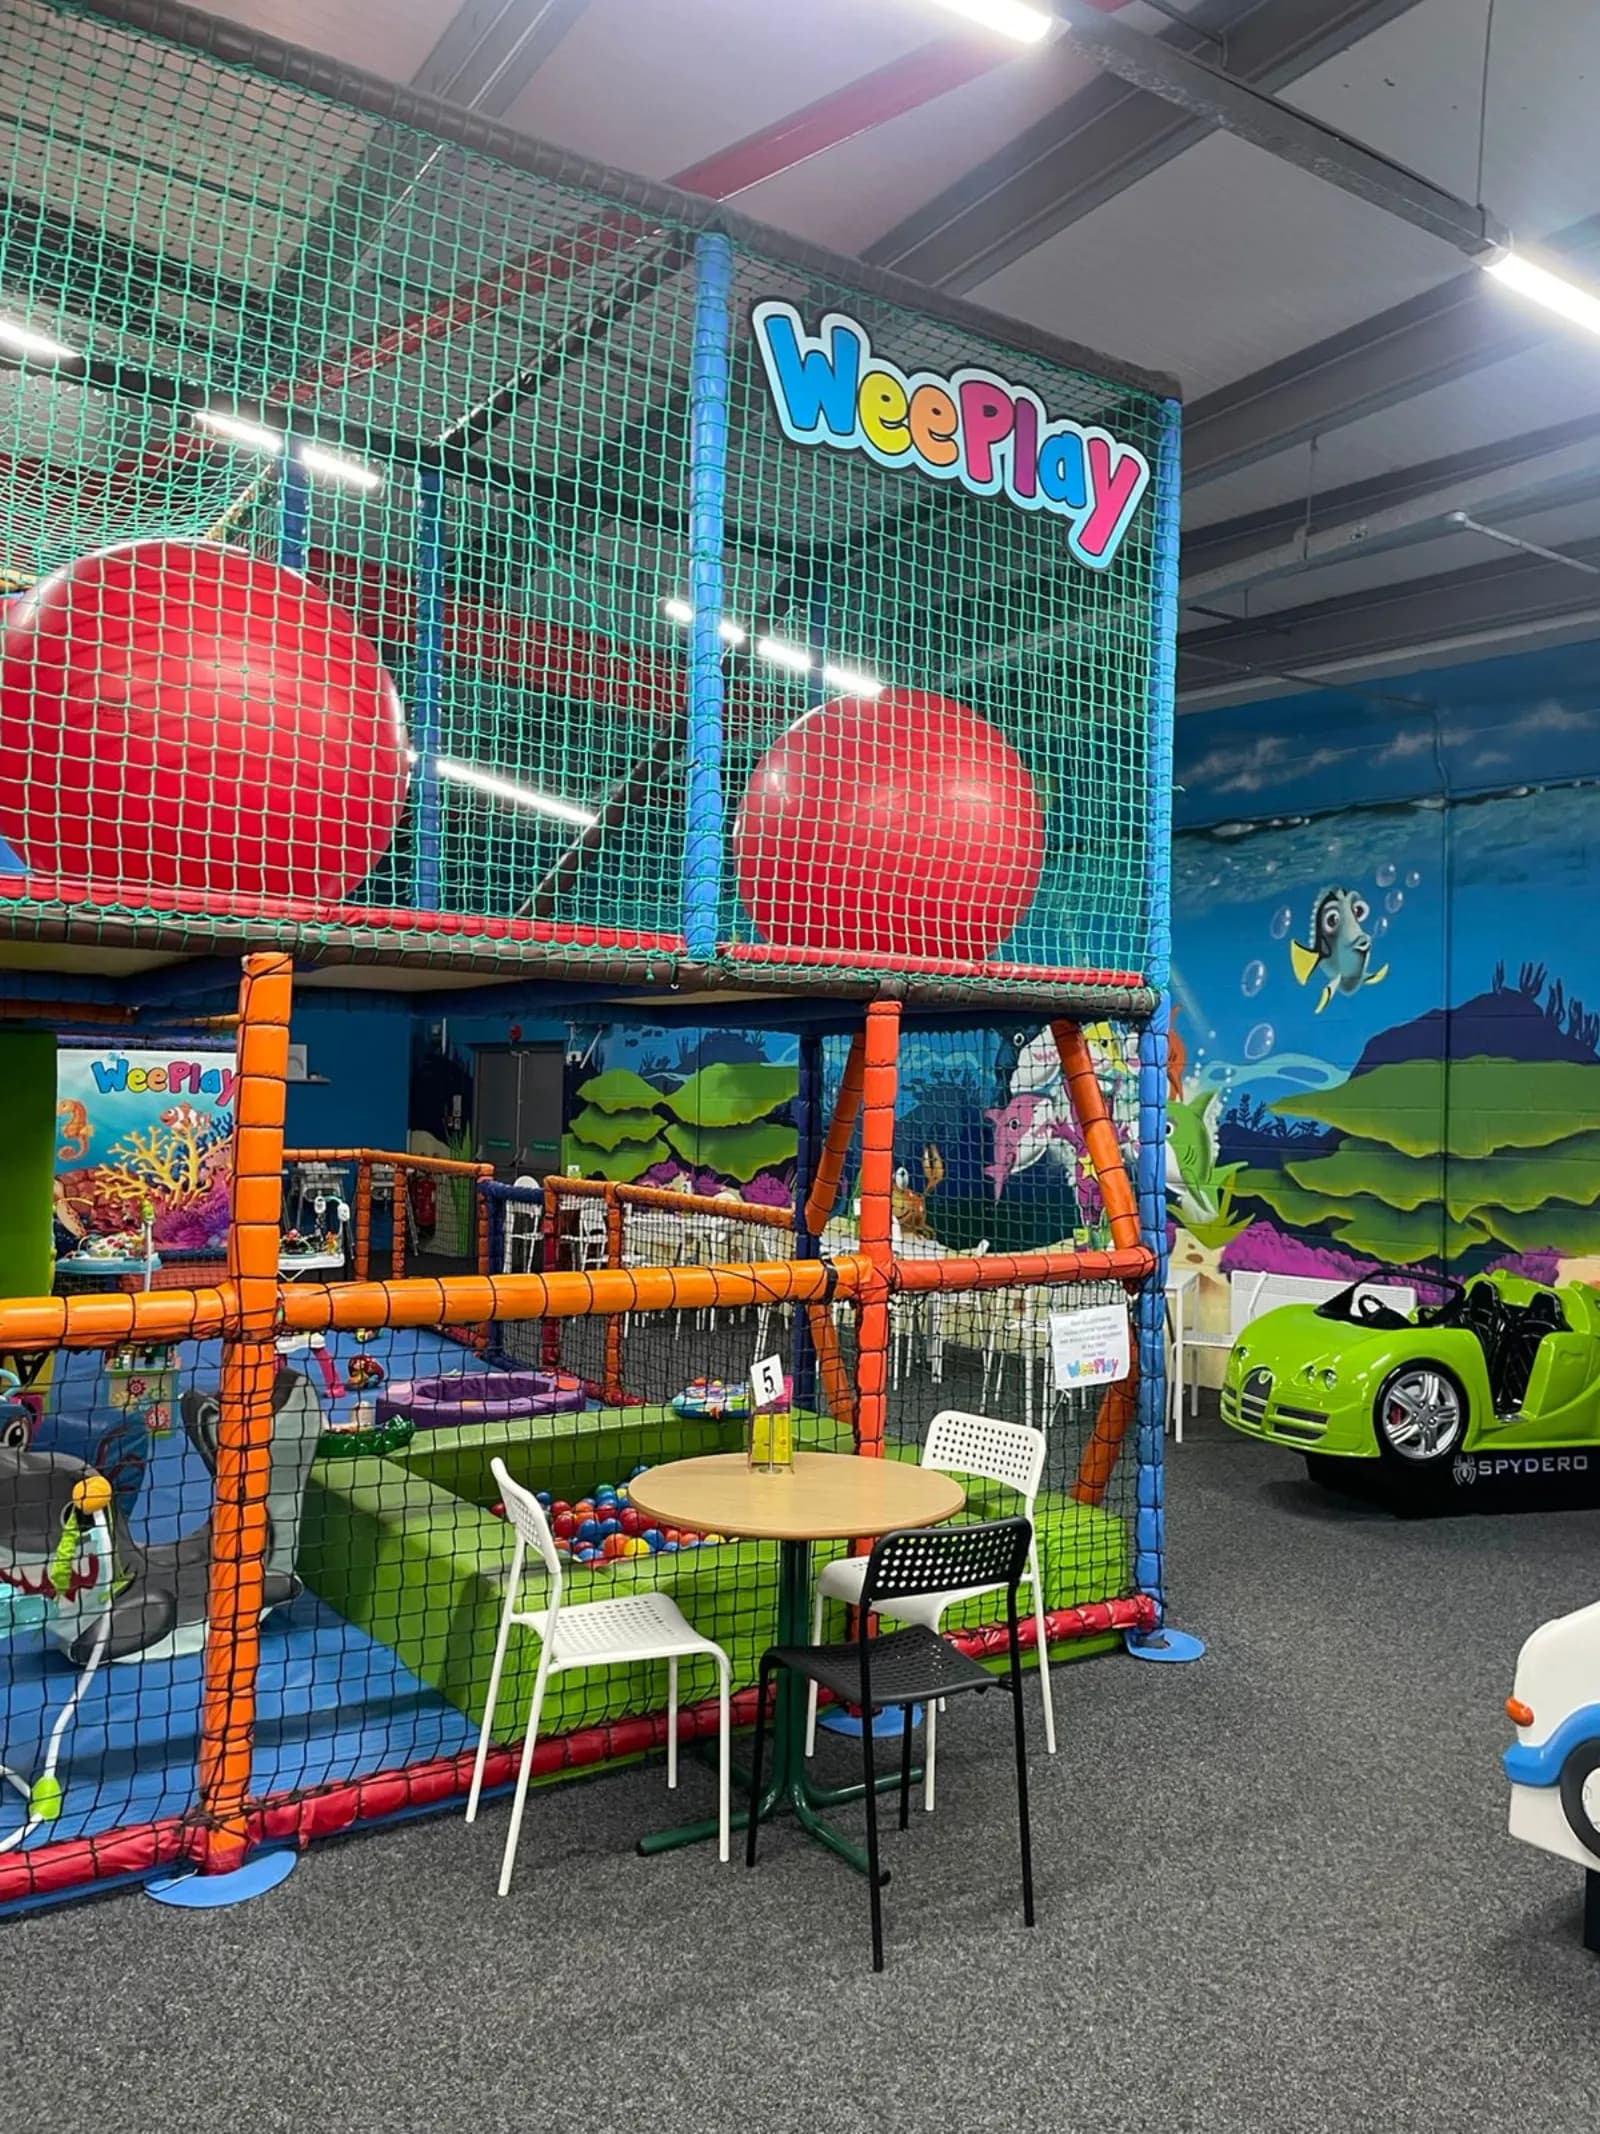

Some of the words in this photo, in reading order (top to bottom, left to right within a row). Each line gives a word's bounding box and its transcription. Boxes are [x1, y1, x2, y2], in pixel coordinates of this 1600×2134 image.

[761, 311, 1144, 558] WeePlay
[90, 1058, 238, 1107] WeePlay
[762, 1365, 775, 1394] 5
[1478, 1455, 1588, 1475] SPYDERO
